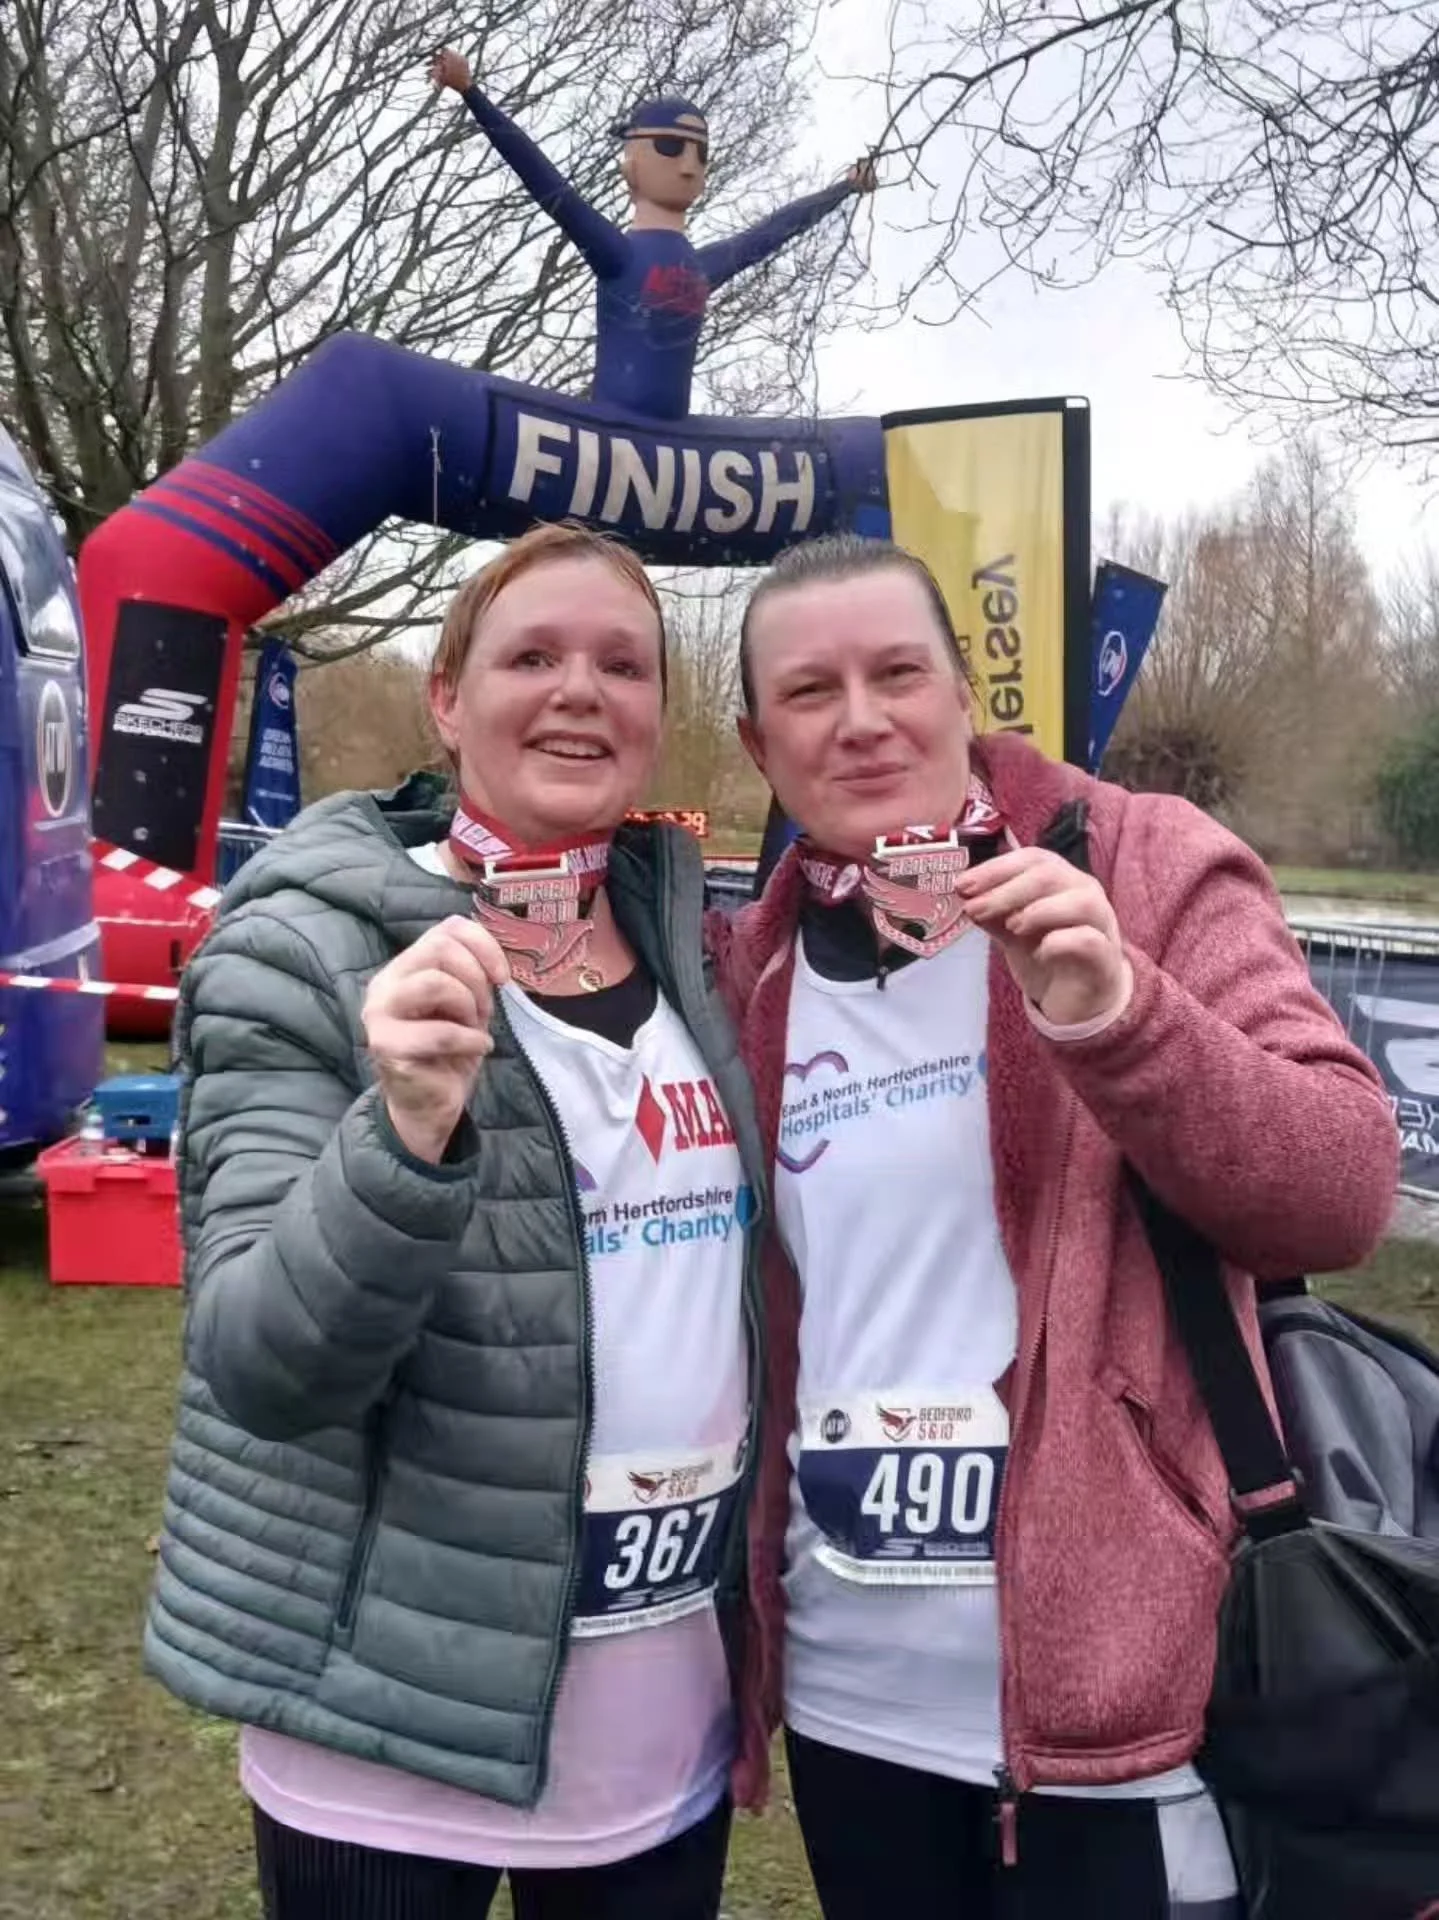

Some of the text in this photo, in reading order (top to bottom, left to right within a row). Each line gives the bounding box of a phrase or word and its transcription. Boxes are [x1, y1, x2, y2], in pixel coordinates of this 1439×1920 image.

[509, 411, 815, 534] FINISH
[809, 1093, 820, 1108] &
[822, 1078, 863, 1102] North
[867, 1055, 971, 1090] Hertfordshire
[885, 1069, 975, 1107] Charity
[613, 1186, 733, 1222] Hertfordshire
[641, 1210, 733, 1246] Charity
[861, 1452, 995, 1534] 490
[603, 1498, 721, 1589] 367
